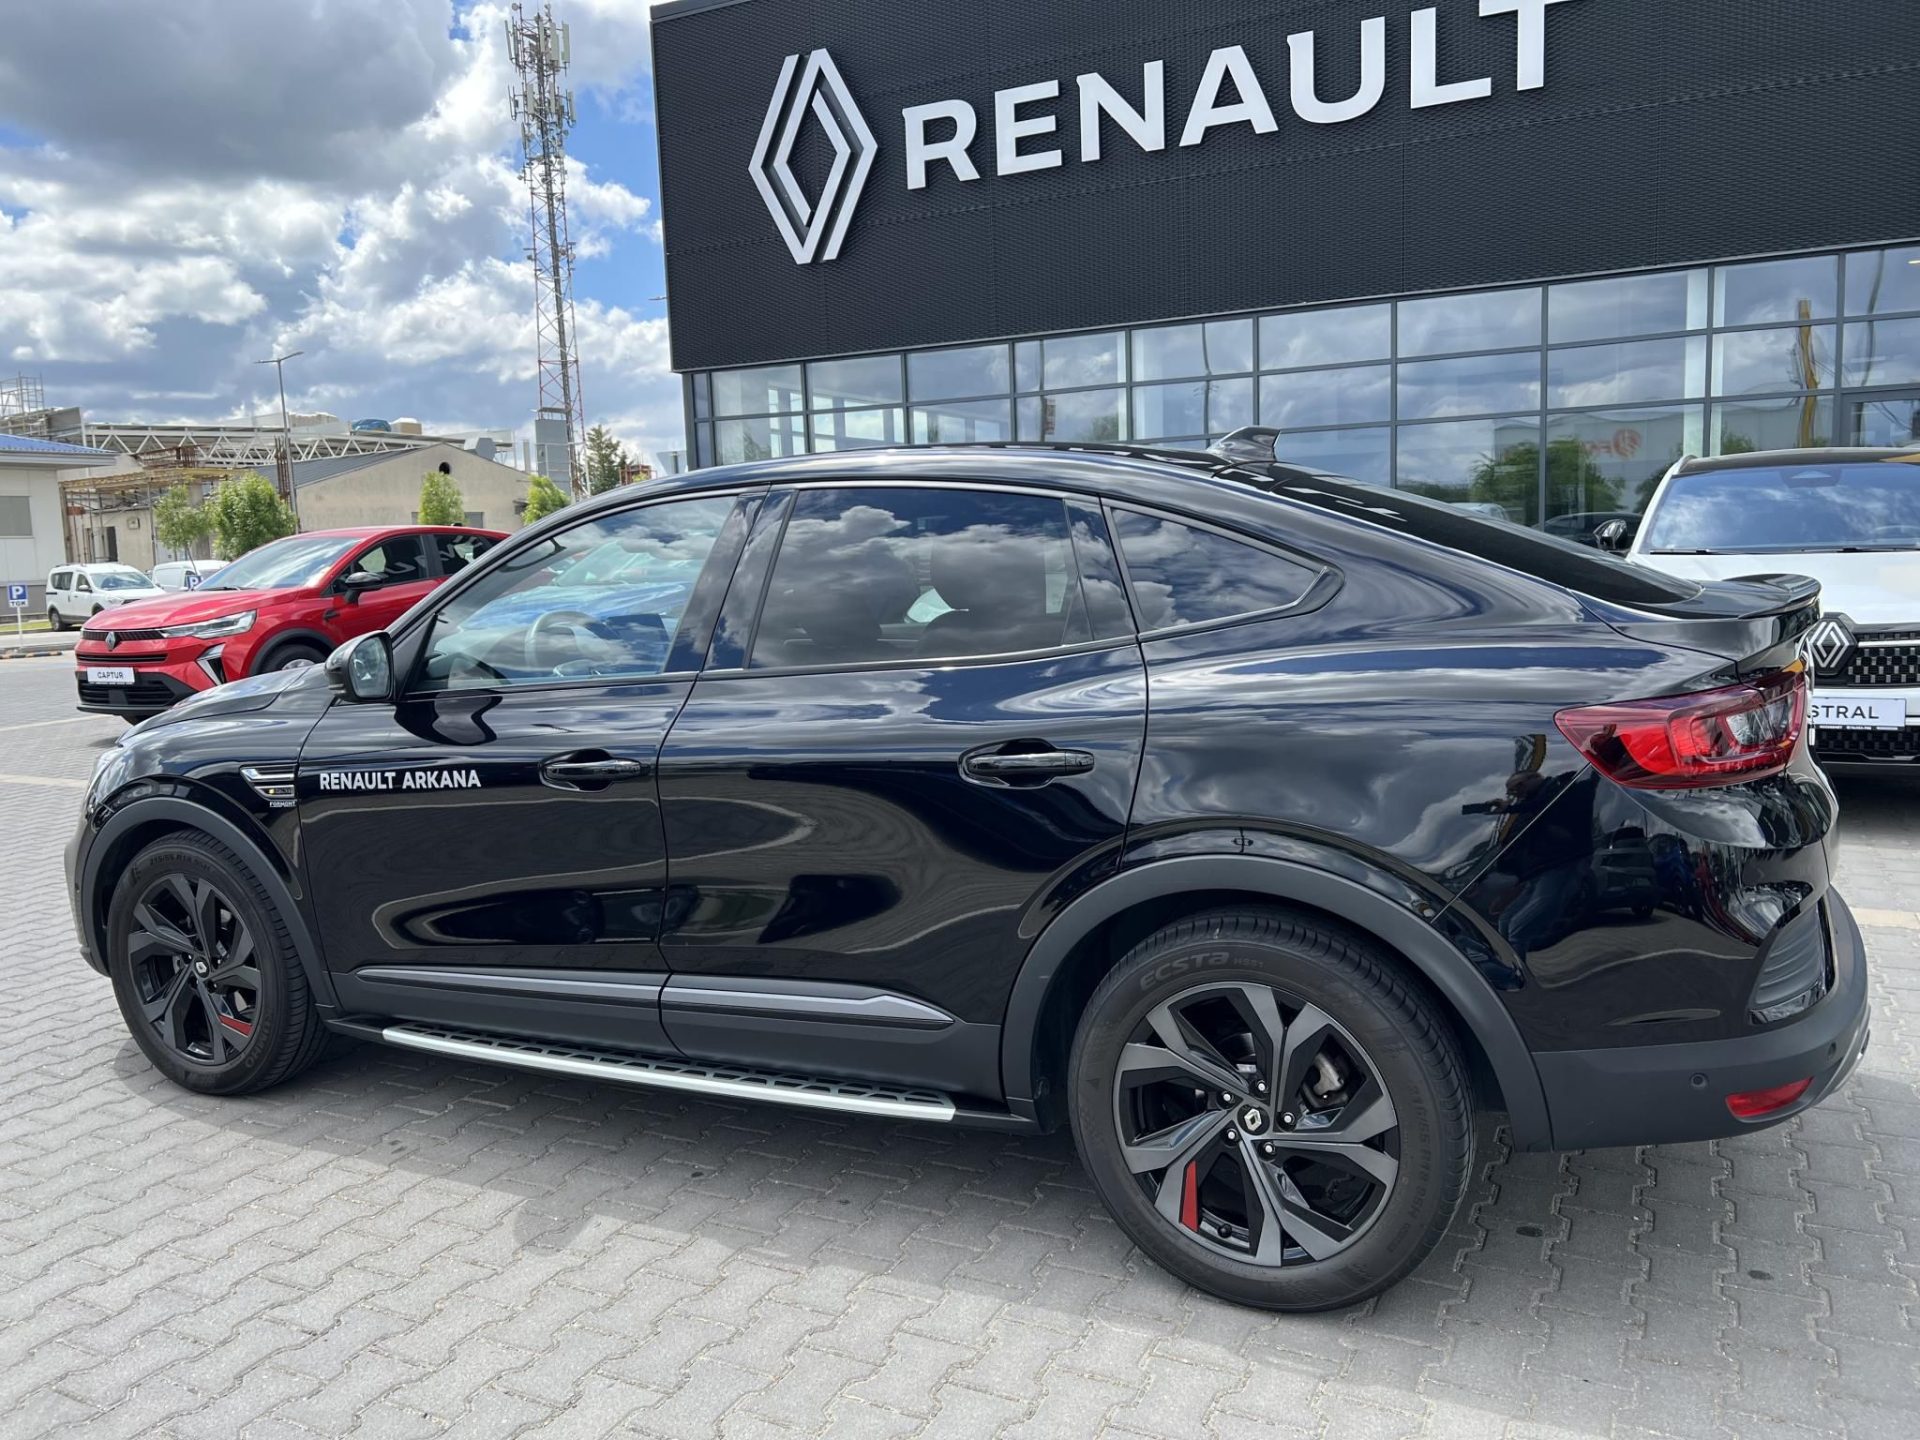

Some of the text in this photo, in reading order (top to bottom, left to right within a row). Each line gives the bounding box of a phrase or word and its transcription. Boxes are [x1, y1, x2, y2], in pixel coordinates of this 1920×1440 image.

[902, 0, 1576, 190] RENAULT
[12, 586, 24, 599] P
[97, 671, 124, 679] CAPTUR
[319, 769, 481, 790] RENAULT ARKANA
